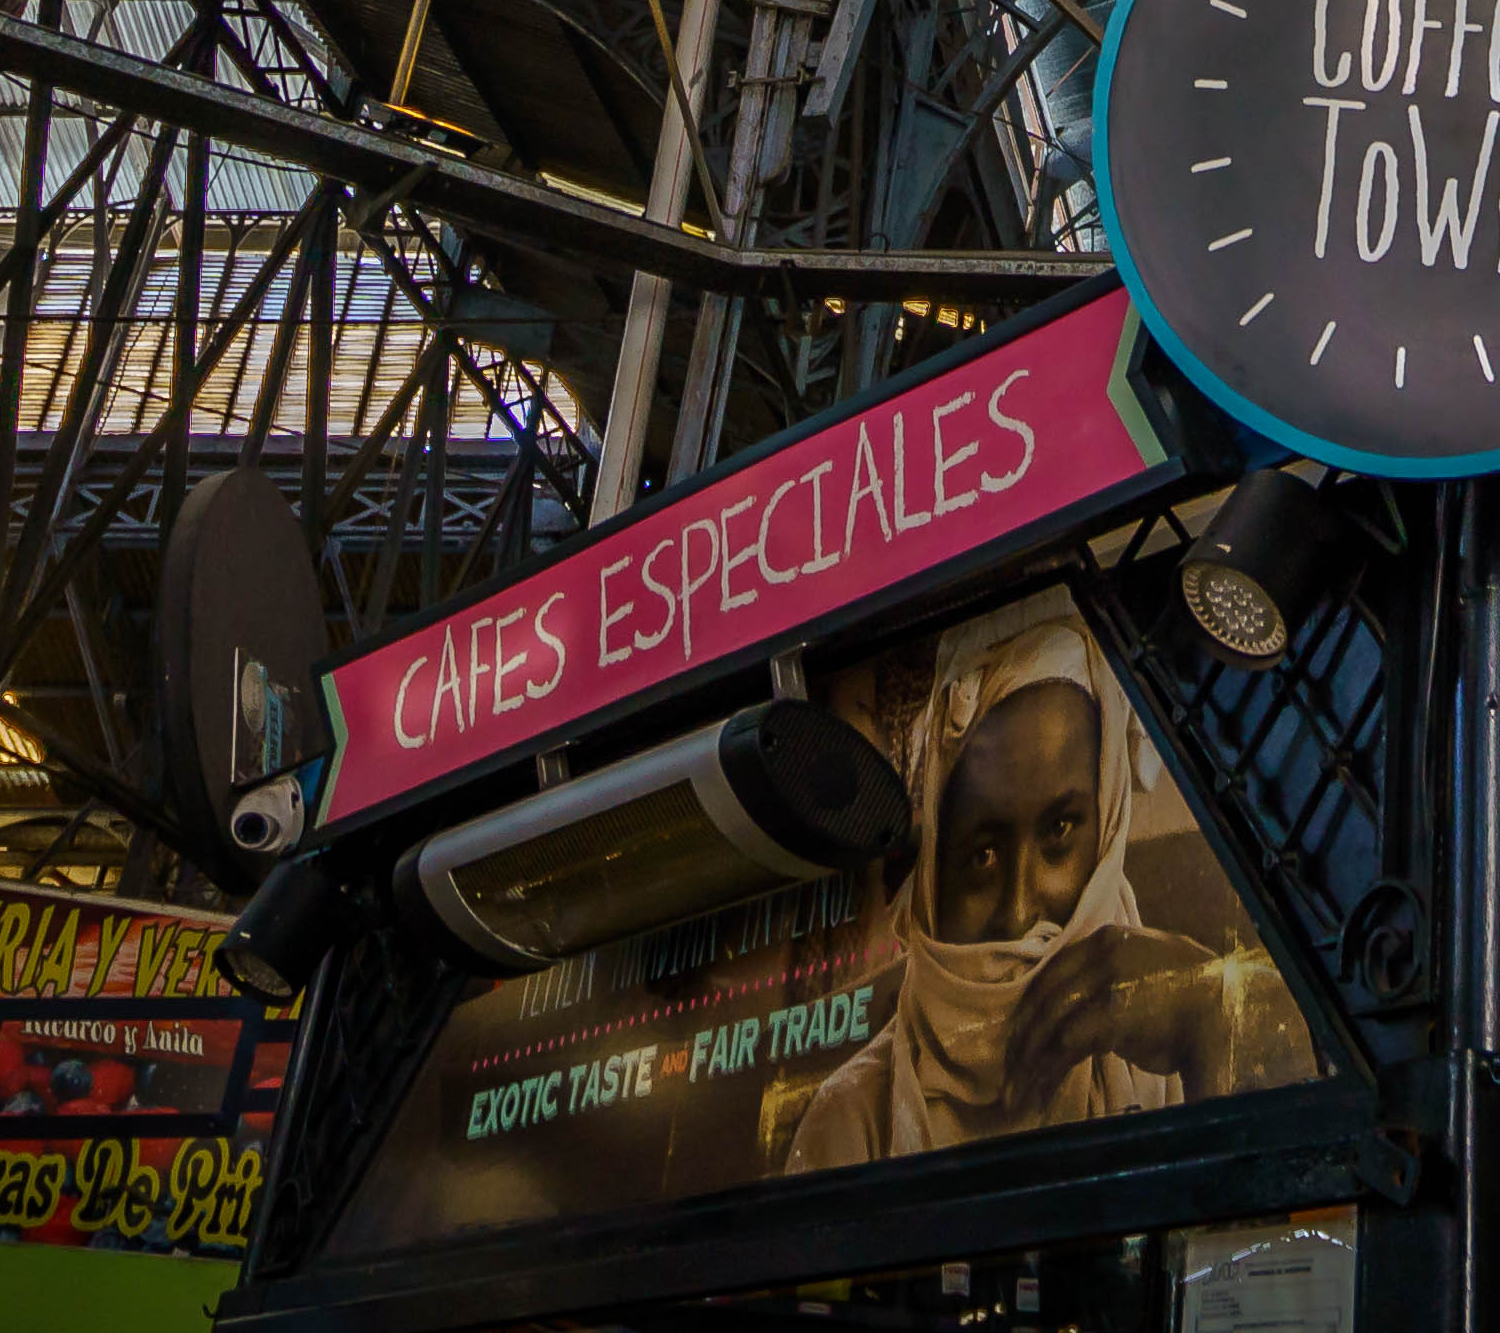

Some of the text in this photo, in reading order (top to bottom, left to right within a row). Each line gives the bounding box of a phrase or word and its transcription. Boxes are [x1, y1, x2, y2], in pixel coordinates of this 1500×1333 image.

[394, 369, 1036, 750] CAFES ESPECIALES
[87, 914, 132, 998] Y
[124, 1025, 139, 1055] y
[142, 1020, 205, 1057] Anita
[466, 986, 875, 1140] EXOTIC TASTE AND FAIR TRADE
